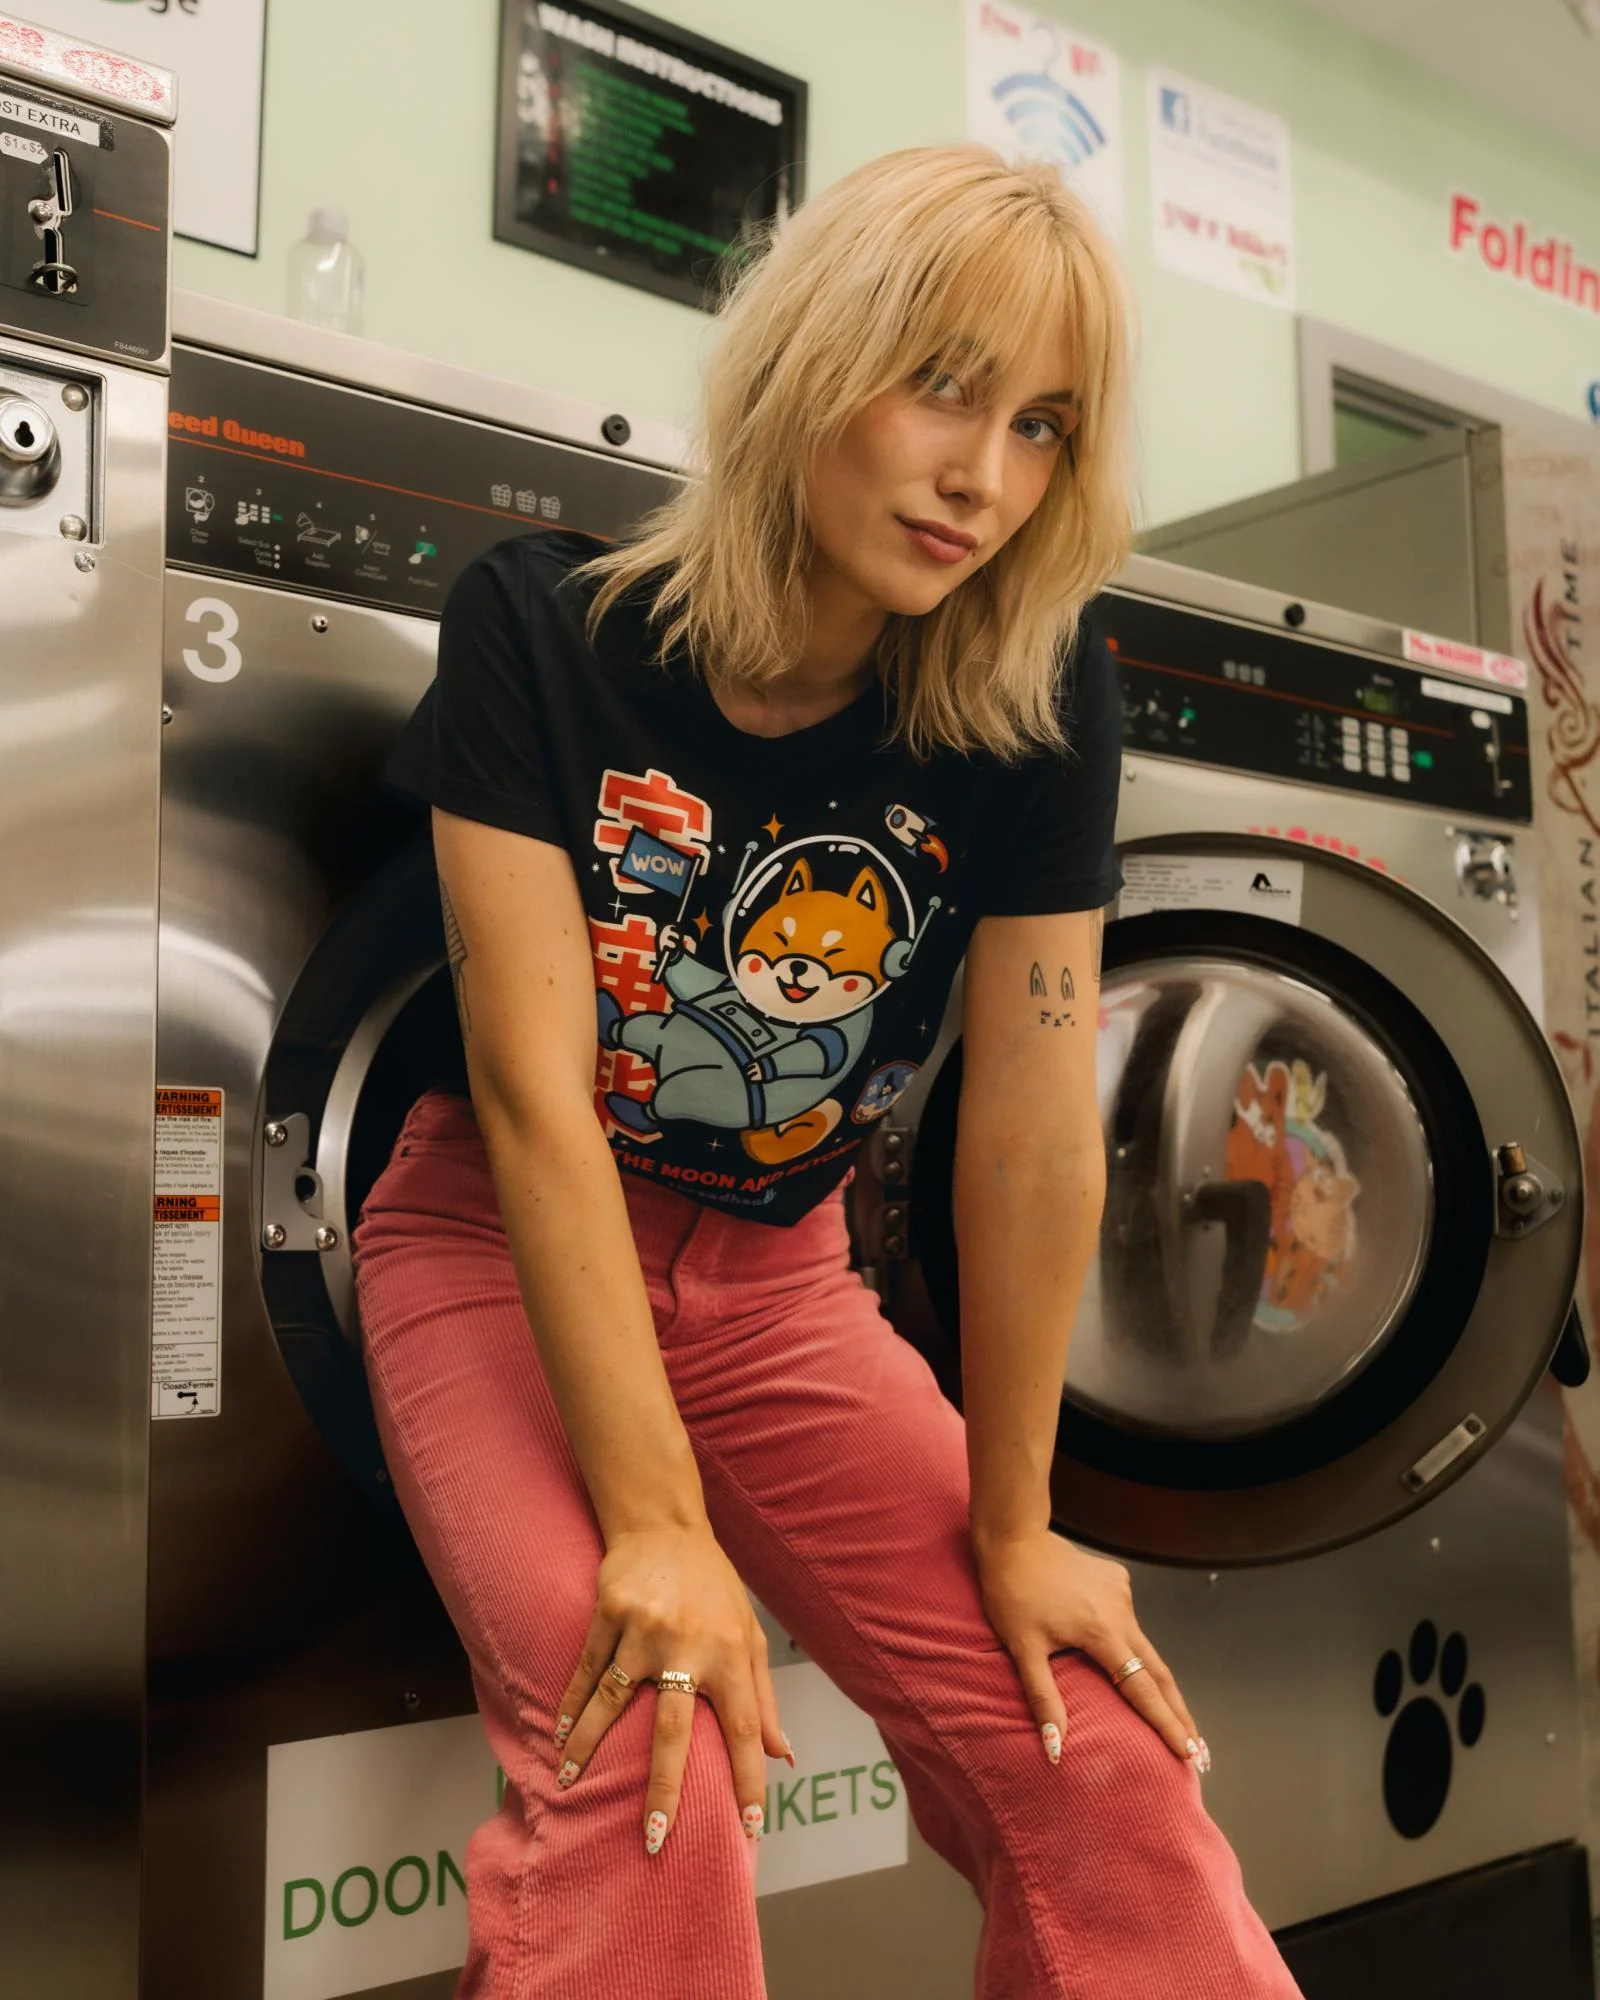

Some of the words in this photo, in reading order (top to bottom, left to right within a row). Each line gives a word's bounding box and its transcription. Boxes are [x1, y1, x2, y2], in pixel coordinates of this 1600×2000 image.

[0, 100, 22, 116] ST
[28, 108, 81, 135] EXTRA
[4, 135, 18, 148] $1
[1450, 192, 1600, 316] Foldin
[168, 411, 218, 437] eed
[222, 419, 305, 458] Queen
[182, 597, 242, 683] 3
[631, 852, 685, 877] WOW
[611, 1148, 655, 1173] THE
[660, 1163, 737, 1189] MOON
[739, 1170, 785, 1193] AND
[156, 1197, 197, 1208] RNING
